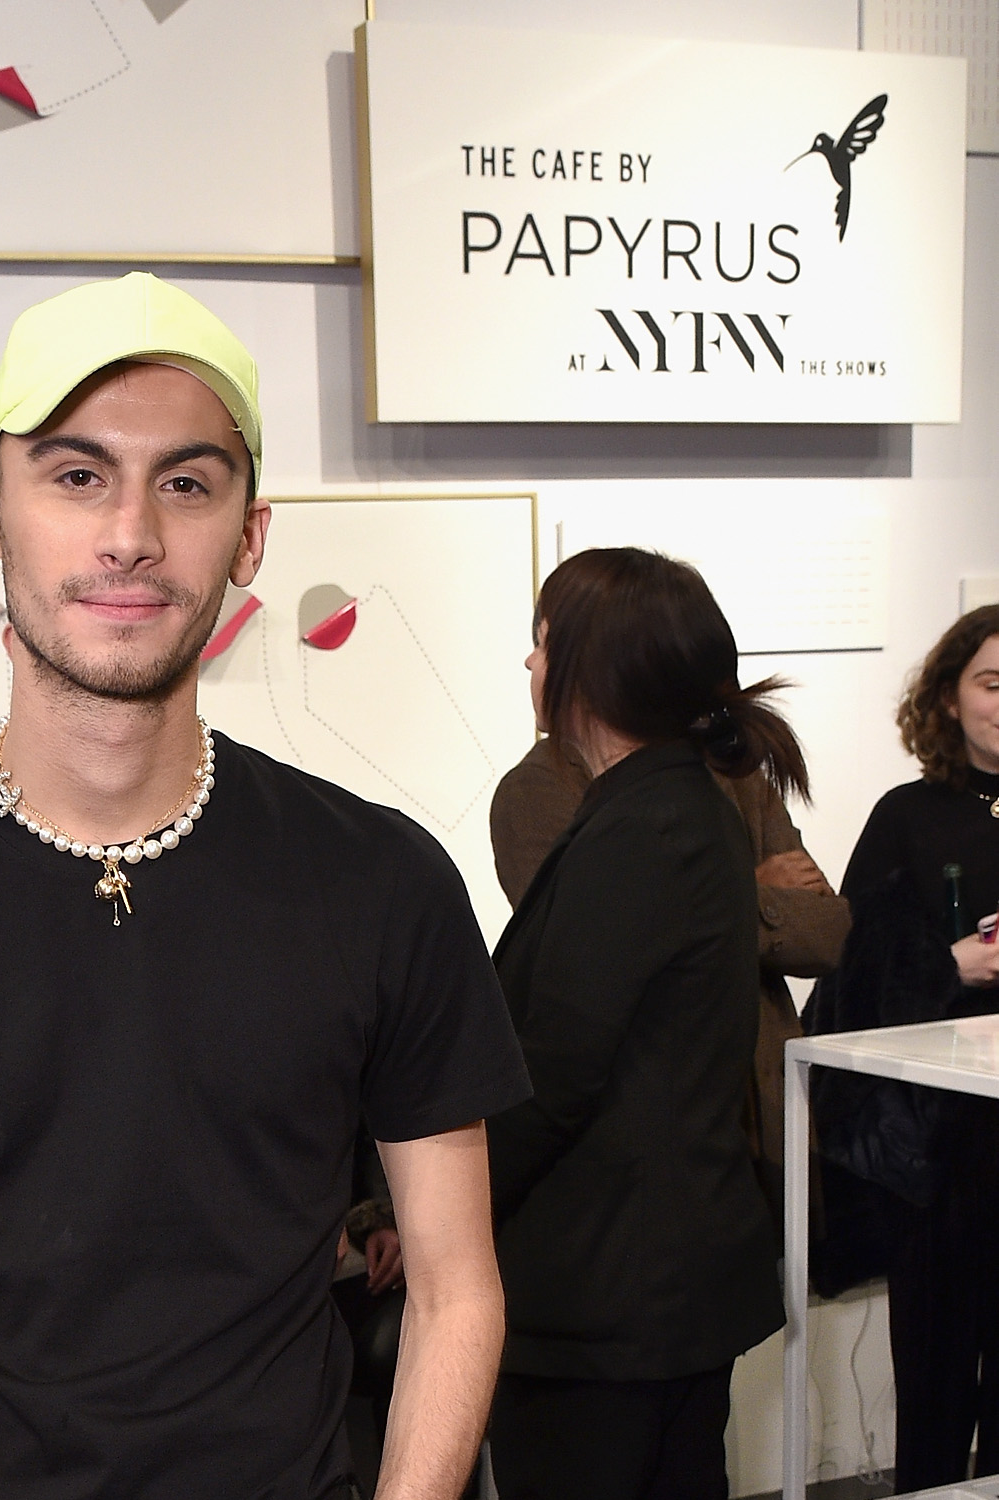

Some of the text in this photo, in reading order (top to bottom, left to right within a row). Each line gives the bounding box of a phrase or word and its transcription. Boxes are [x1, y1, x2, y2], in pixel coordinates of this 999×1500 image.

[460, 145, 652, 184] THE CAFE BY
[461, 209, 801, 285] PAPYRUS
[567, 308, 887, 376] AT NYFW THE SHOWS
